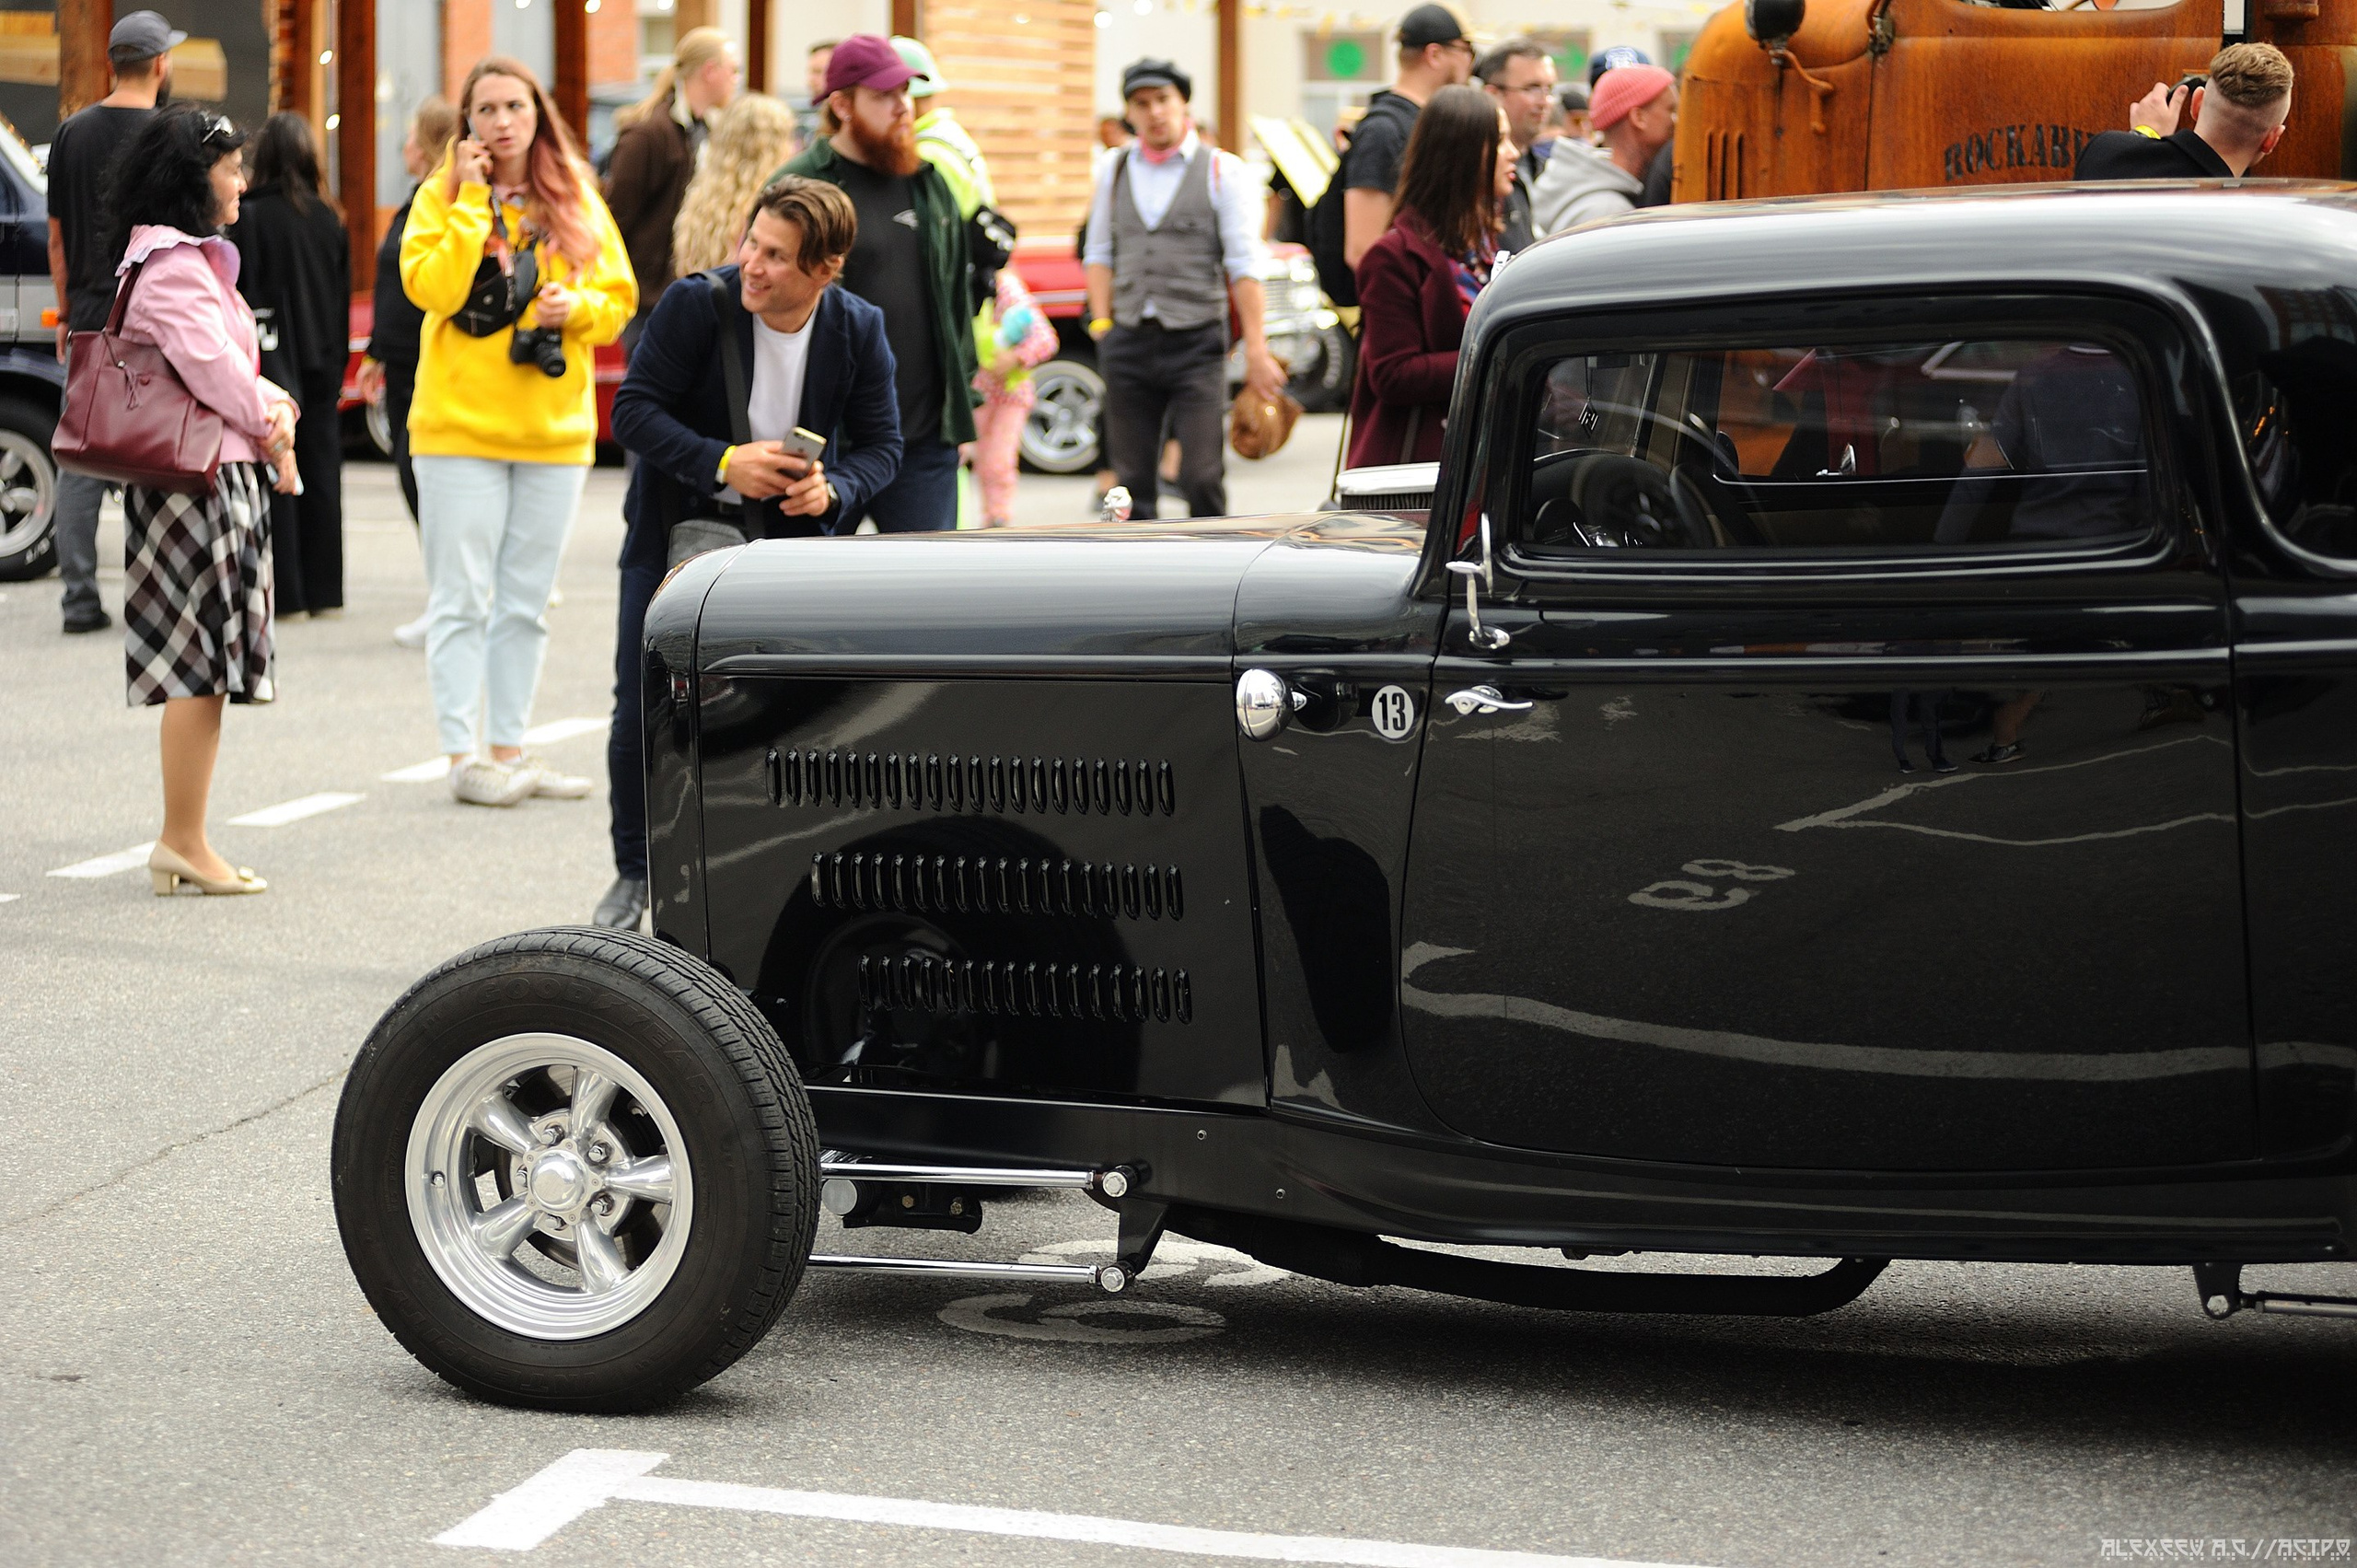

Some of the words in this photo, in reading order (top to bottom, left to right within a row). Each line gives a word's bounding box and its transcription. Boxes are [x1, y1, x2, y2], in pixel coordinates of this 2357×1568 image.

[1944, 123, 2096, 181] ROCKABI
[1378, 692, 1406, 731] 13
[477, 976, 719, 1107] GOODYEAR
